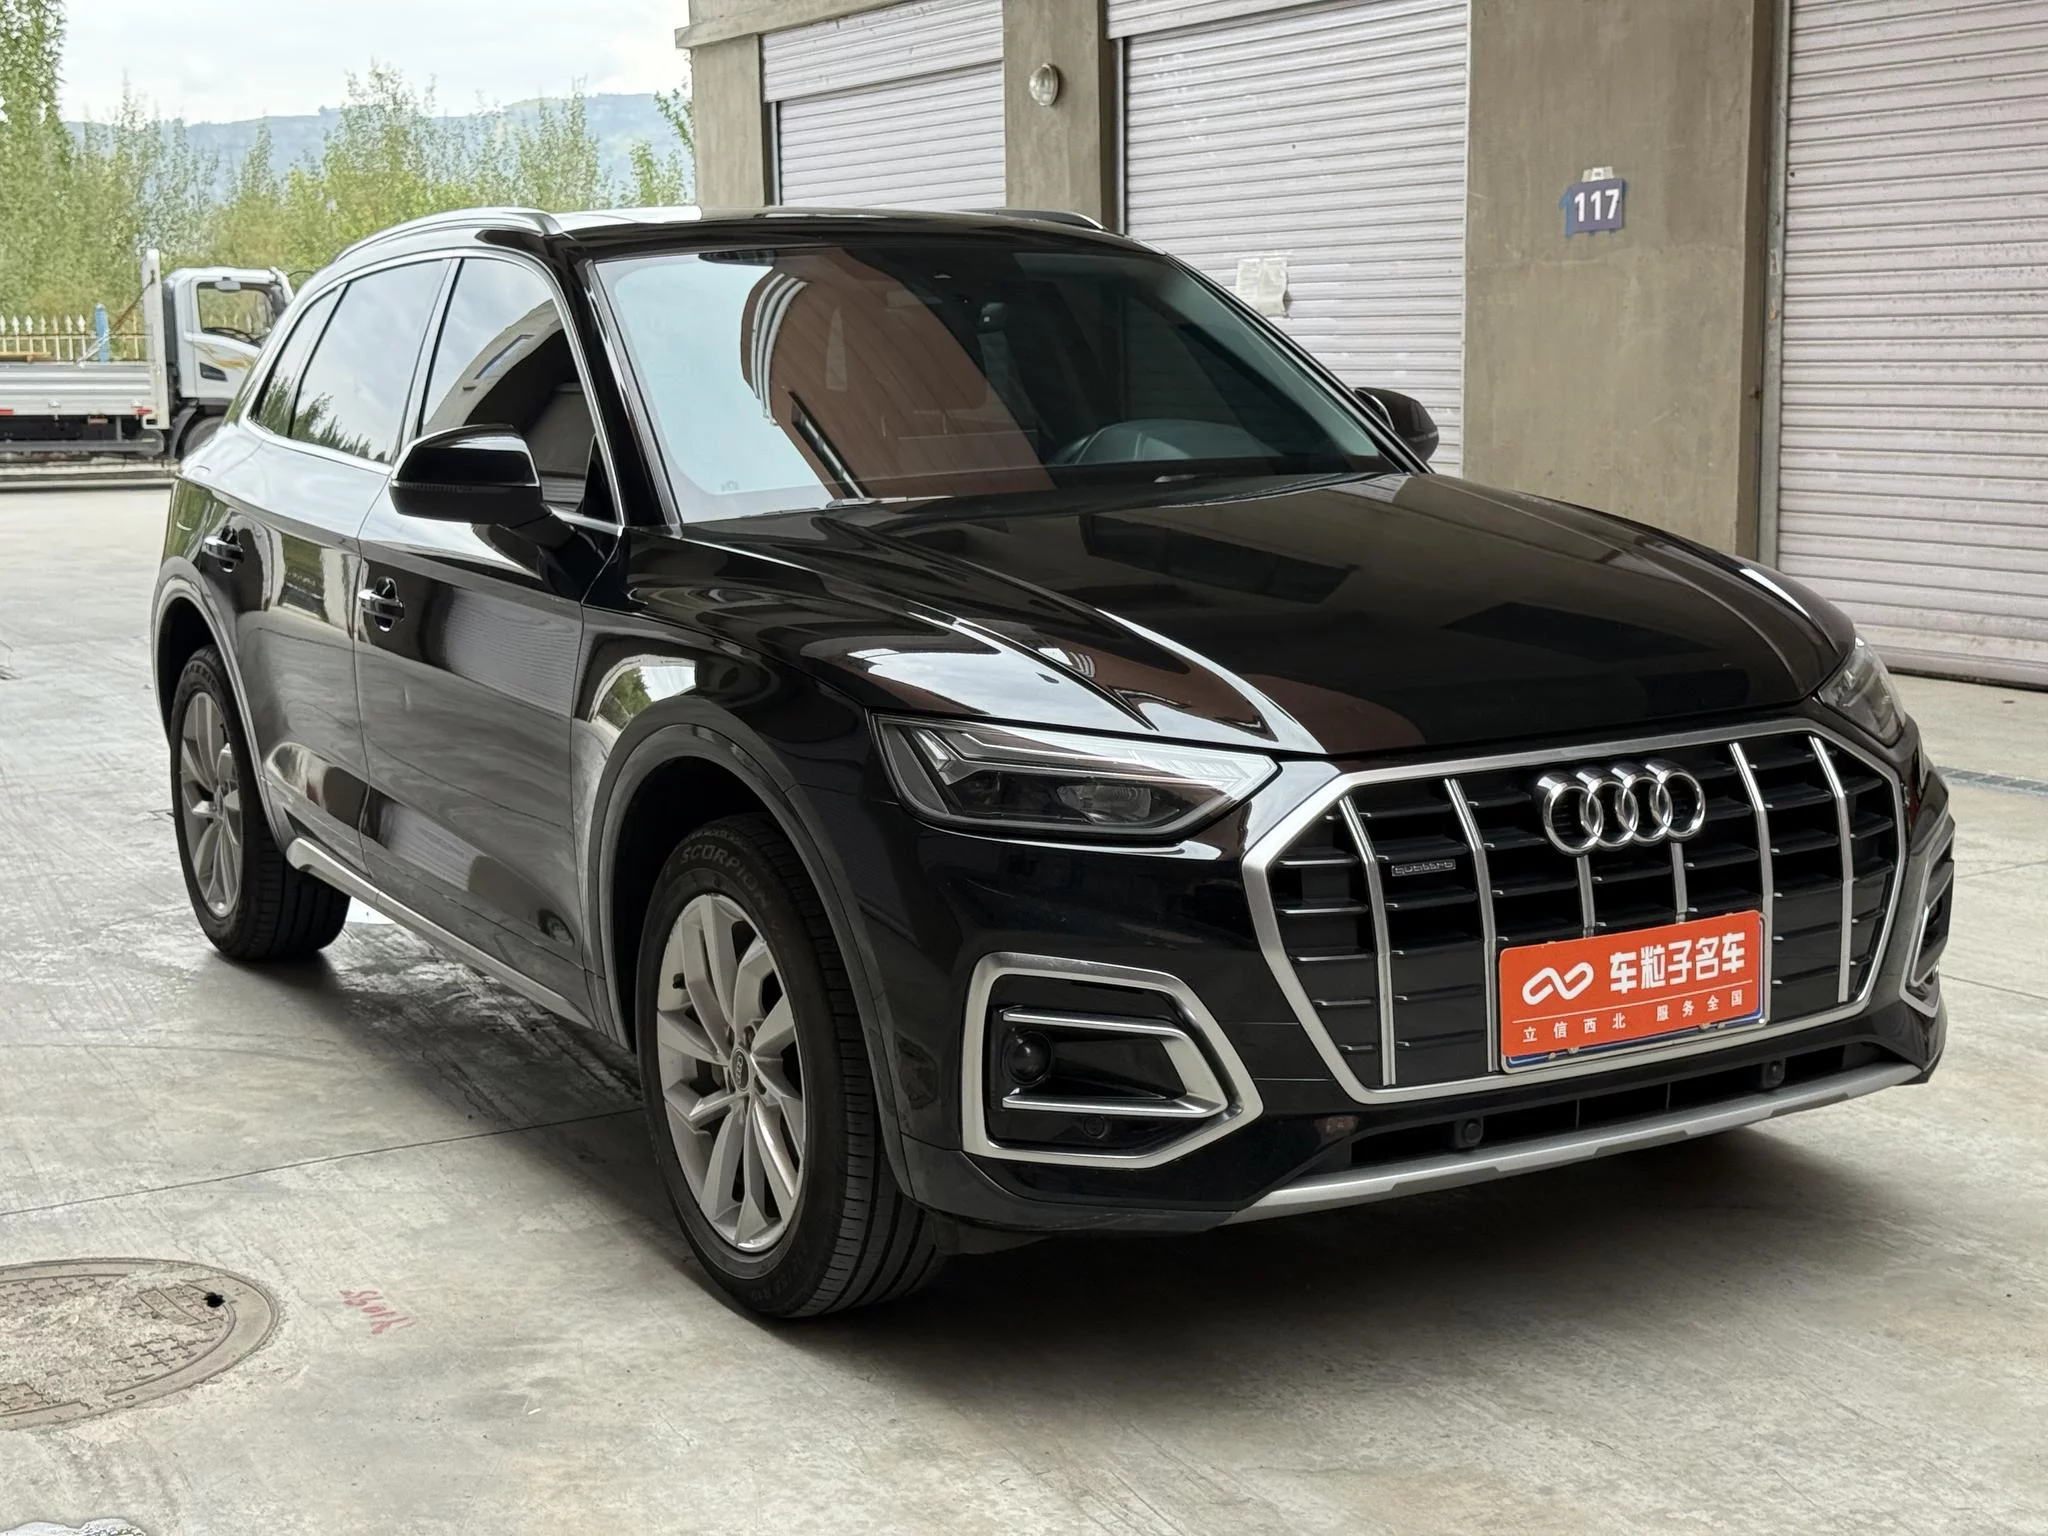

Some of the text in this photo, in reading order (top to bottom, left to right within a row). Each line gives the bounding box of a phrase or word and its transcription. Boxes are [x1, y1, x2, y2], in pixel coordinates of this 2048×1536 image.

[1574, 188, 1620, 222] 117
[1609, 932, 1746, 994] 车粒子名车
[1522, 989, 1744, 1043] 立信西北 服务全国
